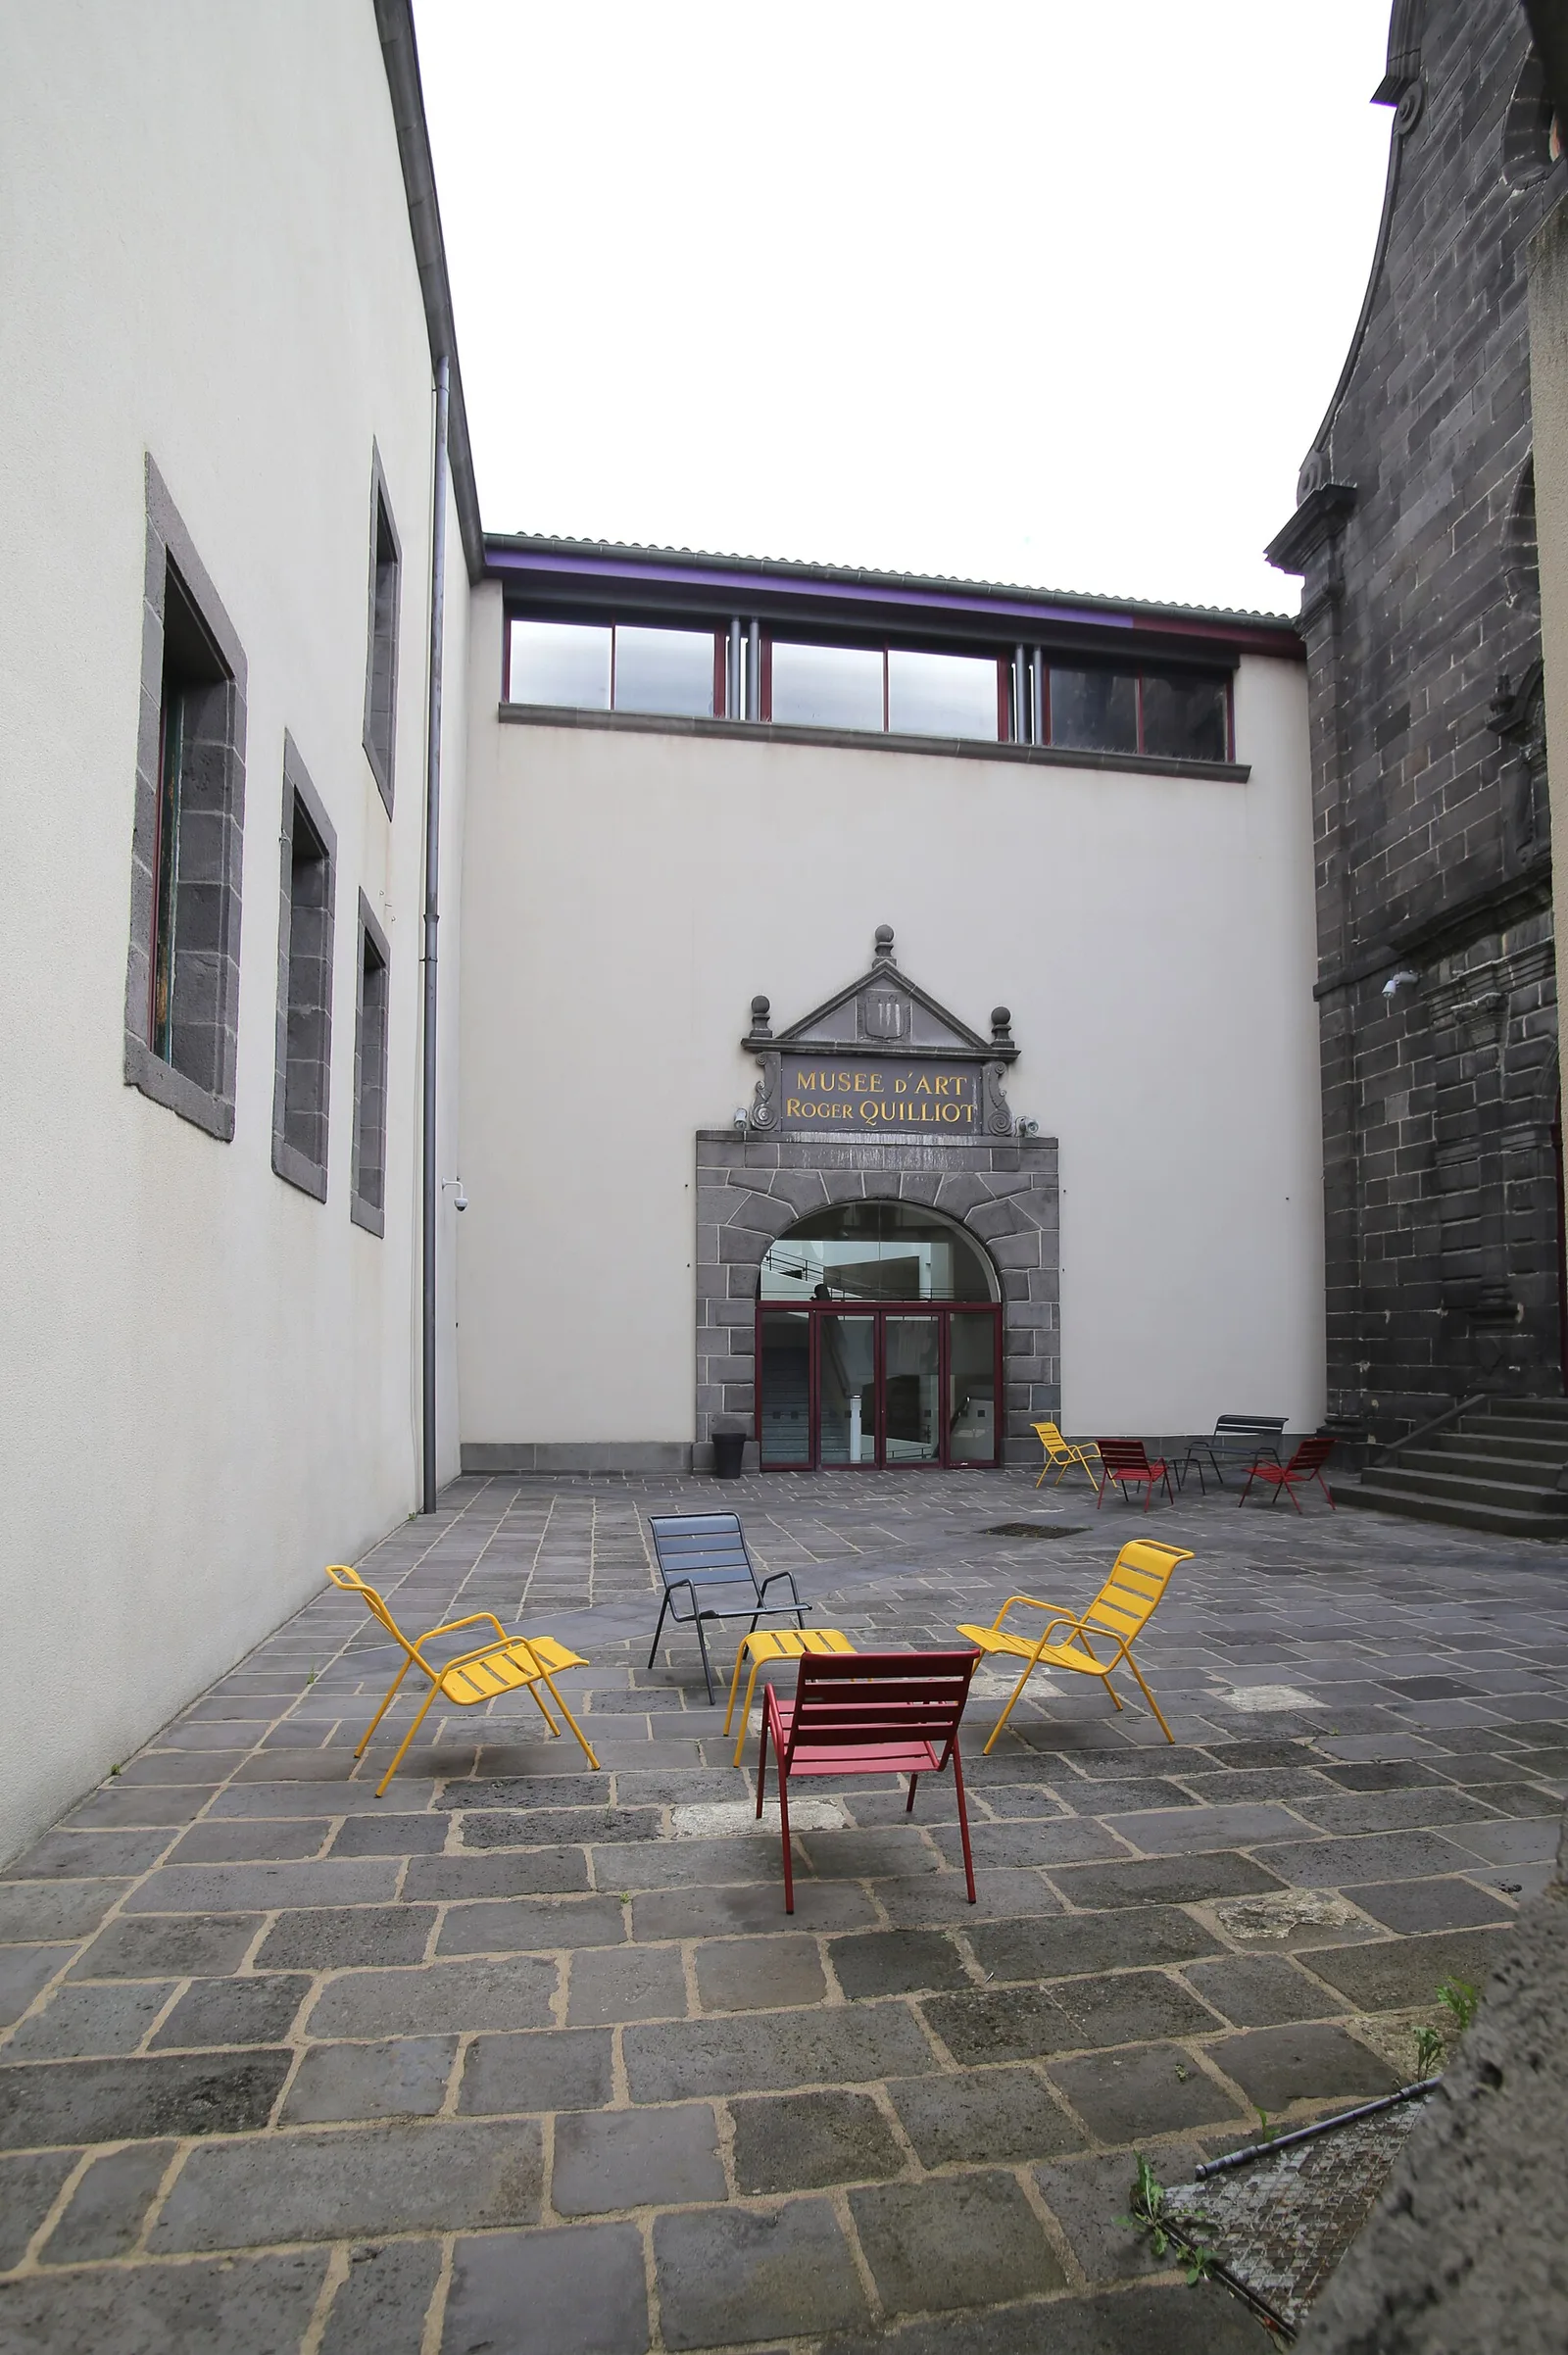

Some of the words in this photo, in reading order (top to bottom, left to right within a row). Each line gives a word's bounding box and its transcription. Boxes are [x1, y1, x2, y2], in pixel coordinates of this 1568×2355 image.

[797, 1071, 884, 1093] MUSEE
[786, 1098, 854, 1119] ROGER
[859, 1101, 974, 1126] QUILLIOT
